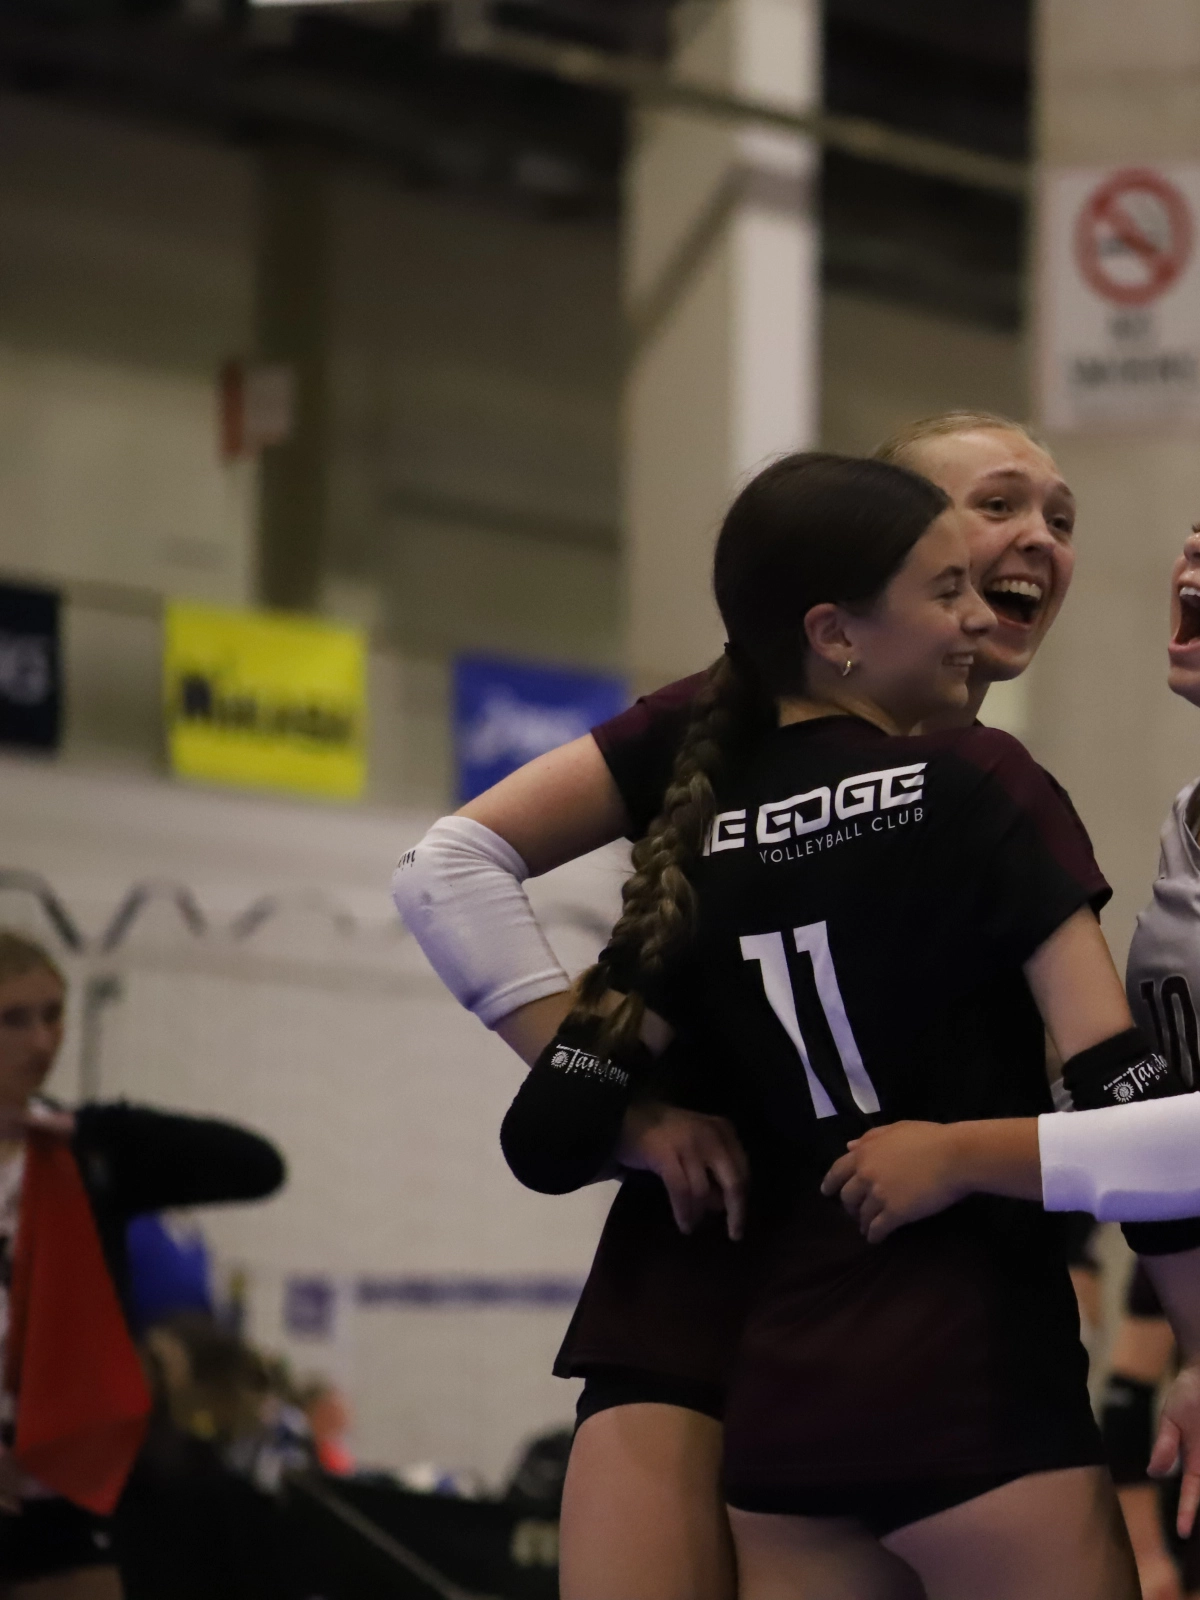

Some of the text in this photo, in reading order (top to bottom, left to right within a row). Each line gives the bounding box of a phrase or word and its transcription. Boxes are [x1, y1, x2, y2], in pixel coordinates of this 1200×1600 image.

[756, 762, 928, 845] EDGE
[759, 807, 924, 864] VOLLEYBALL CLUB
[739, 920, 881, 1119] 11
